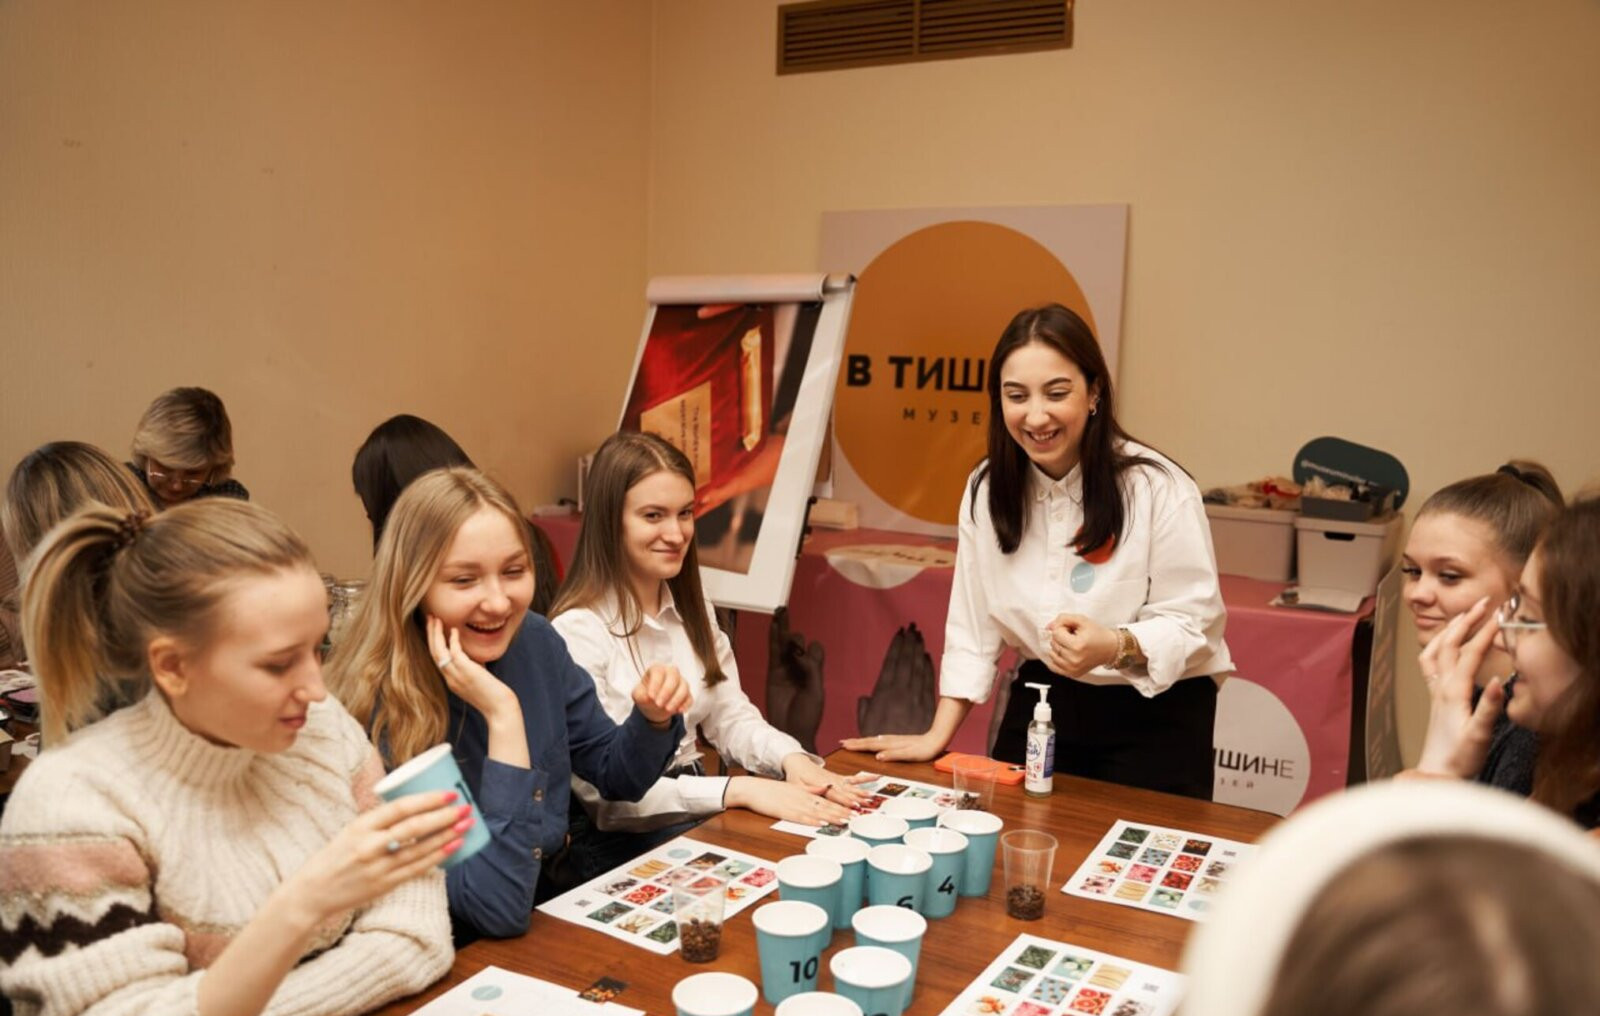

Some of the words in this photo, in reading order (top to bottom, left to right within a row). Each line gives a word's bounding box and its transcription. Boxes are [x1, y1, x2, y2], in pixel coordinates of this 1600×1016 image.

[847, 354, 871, 387] В
[888, 356, 985, 392] ТИШ
[902, 407, 982, 425] МУЗЕ
[1213, 747, 1295, 780] ШИНЕ
[1220, 777, 1254, 789] ЗЕЙ
[937, 875, 955, 895] 4
[789, 956, 819, 984] 10
